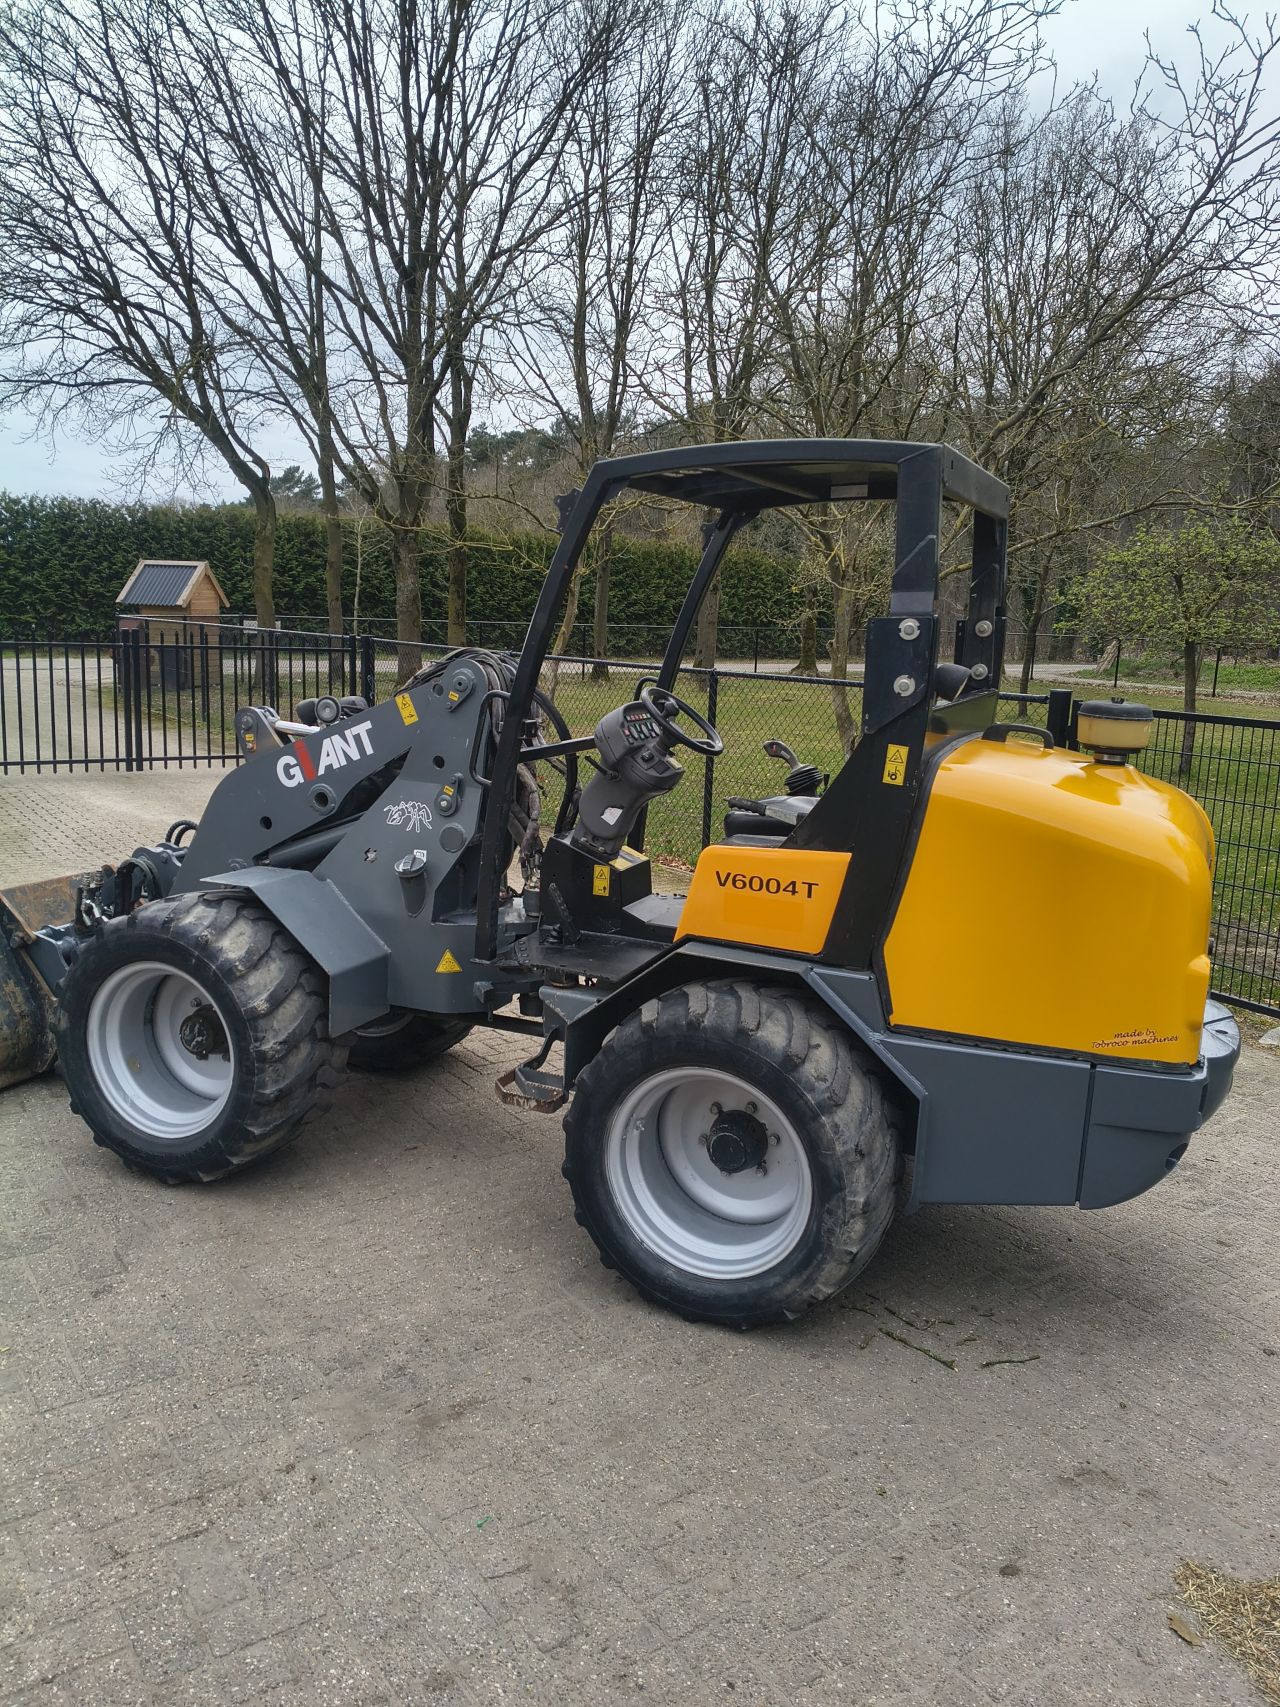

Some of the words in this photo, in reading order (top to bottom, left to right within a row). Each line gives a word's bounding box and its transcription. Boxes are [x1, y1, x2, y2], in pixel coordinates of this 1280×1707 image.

[276, 720, 374, 788] GIANT
[715, 870, 819, 899] V6004T
[1091, 1039, 1129, 1049] Tobroco
[1131, 1035, 1178, 1045] machines
[1114, 1029, 1144, 1039] made
[1145, 1028, 1157, 1037] by
